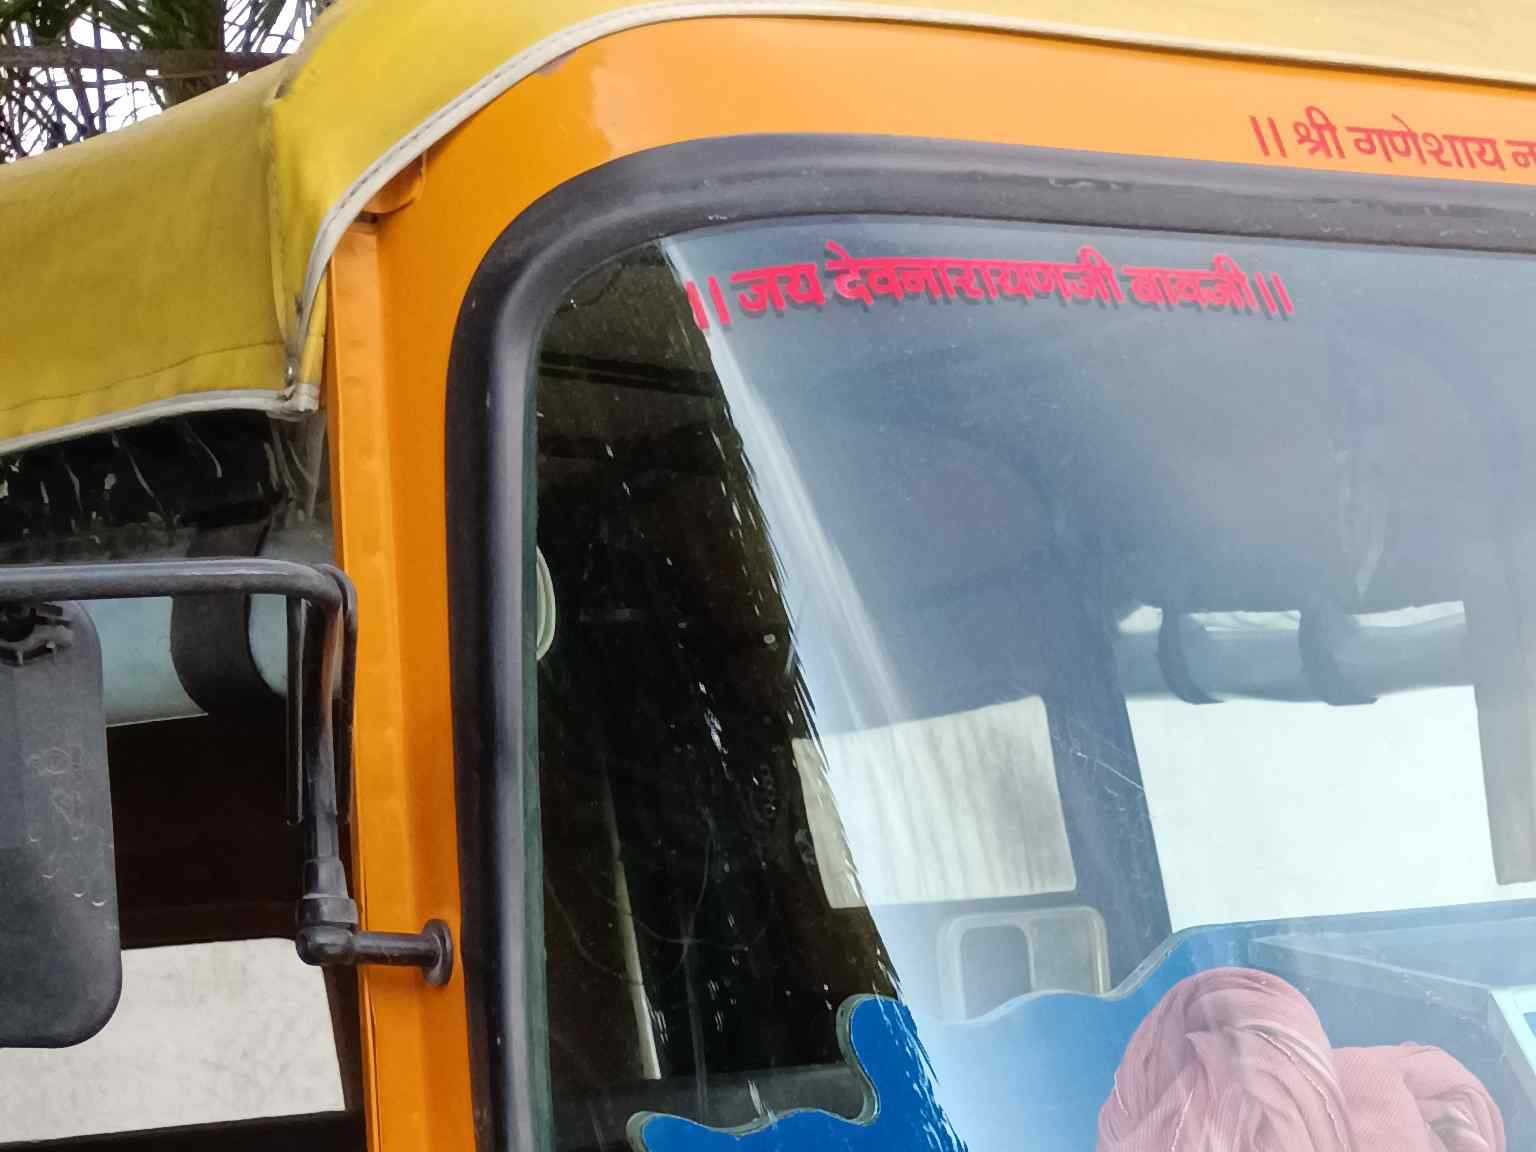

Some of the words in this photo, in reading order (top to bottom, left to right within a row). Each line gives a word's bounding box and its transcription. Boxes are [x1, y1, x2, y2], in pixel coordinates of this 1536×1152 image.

[1293, 105, 1346, 159] श्री
[1346, 114, 1506, 170] गणेशाय
[730, 262, 826, 313] जय
[824, 241, 1122, 307] देवनारायणजी
